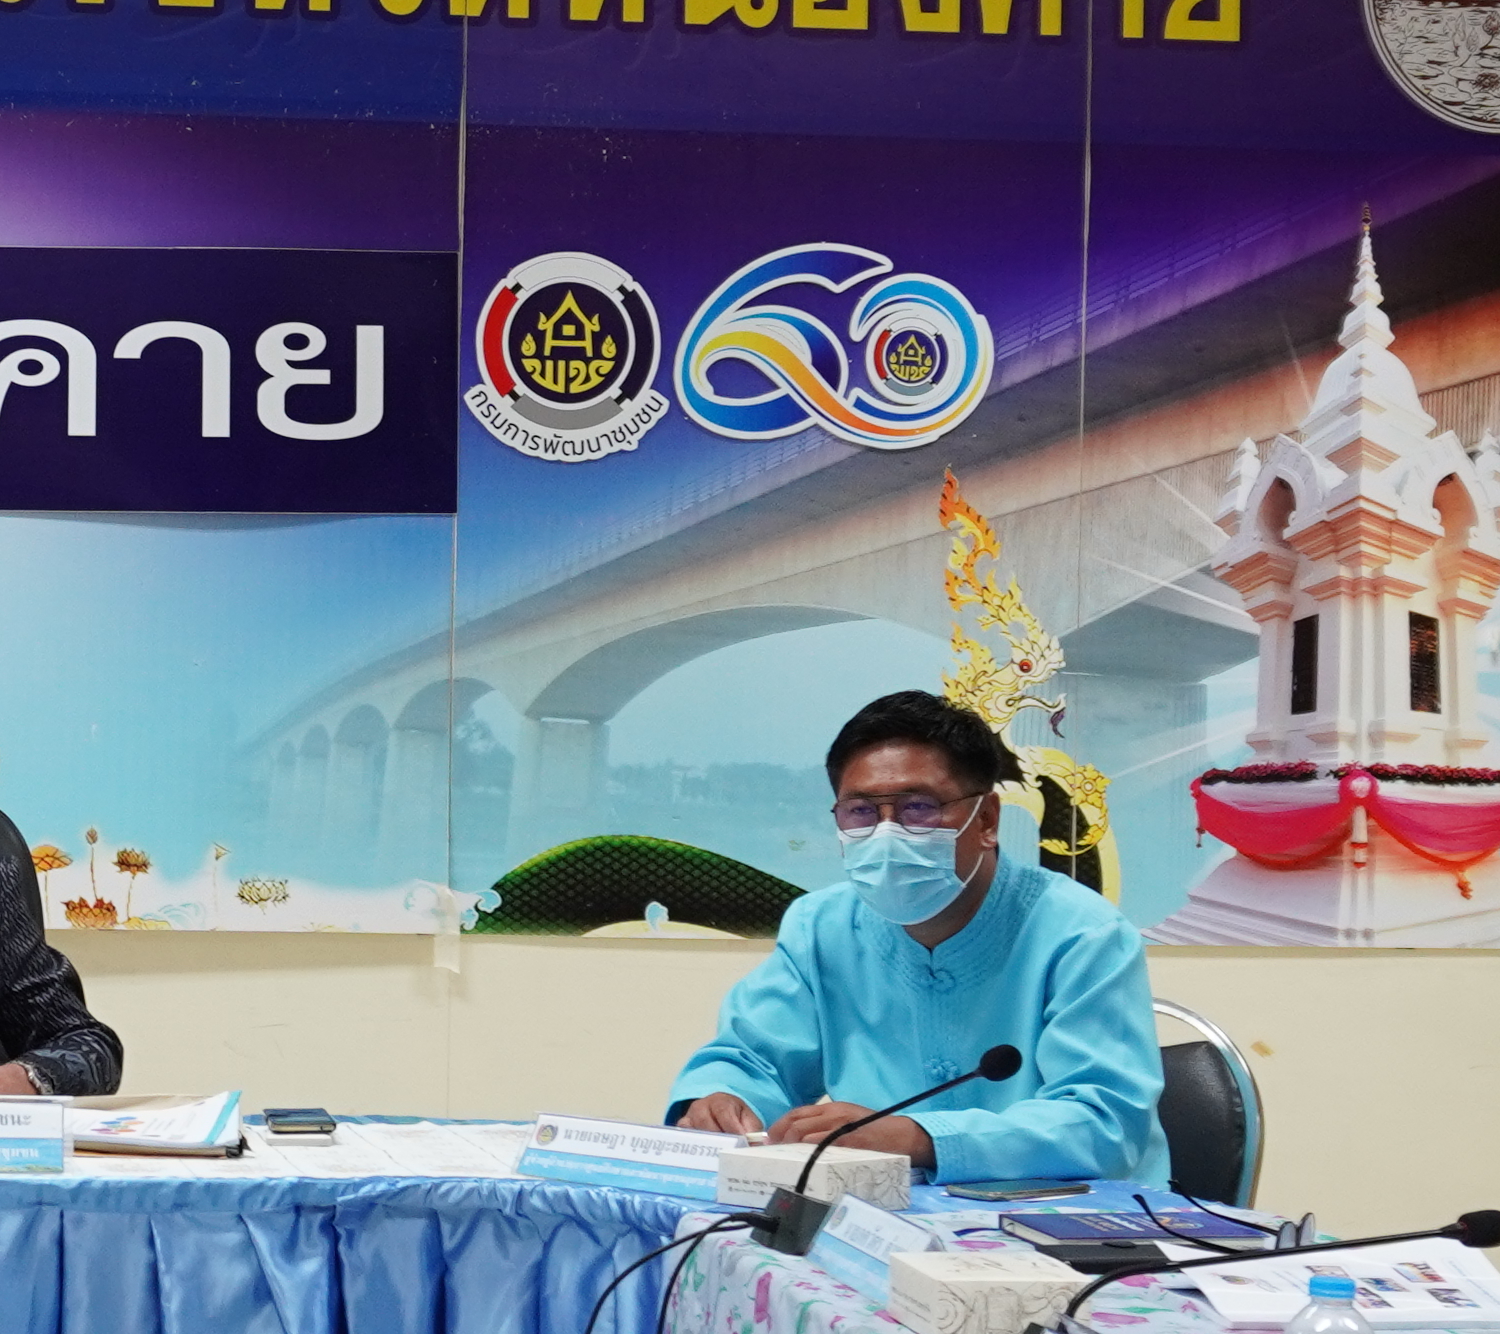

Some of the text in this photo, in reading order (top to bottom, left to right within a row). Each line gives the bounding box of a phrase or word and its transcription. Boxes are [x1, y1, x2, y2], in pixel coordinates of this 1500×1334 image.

[468, 388, 664, 456] กรมการพัฒนาชุมชน
